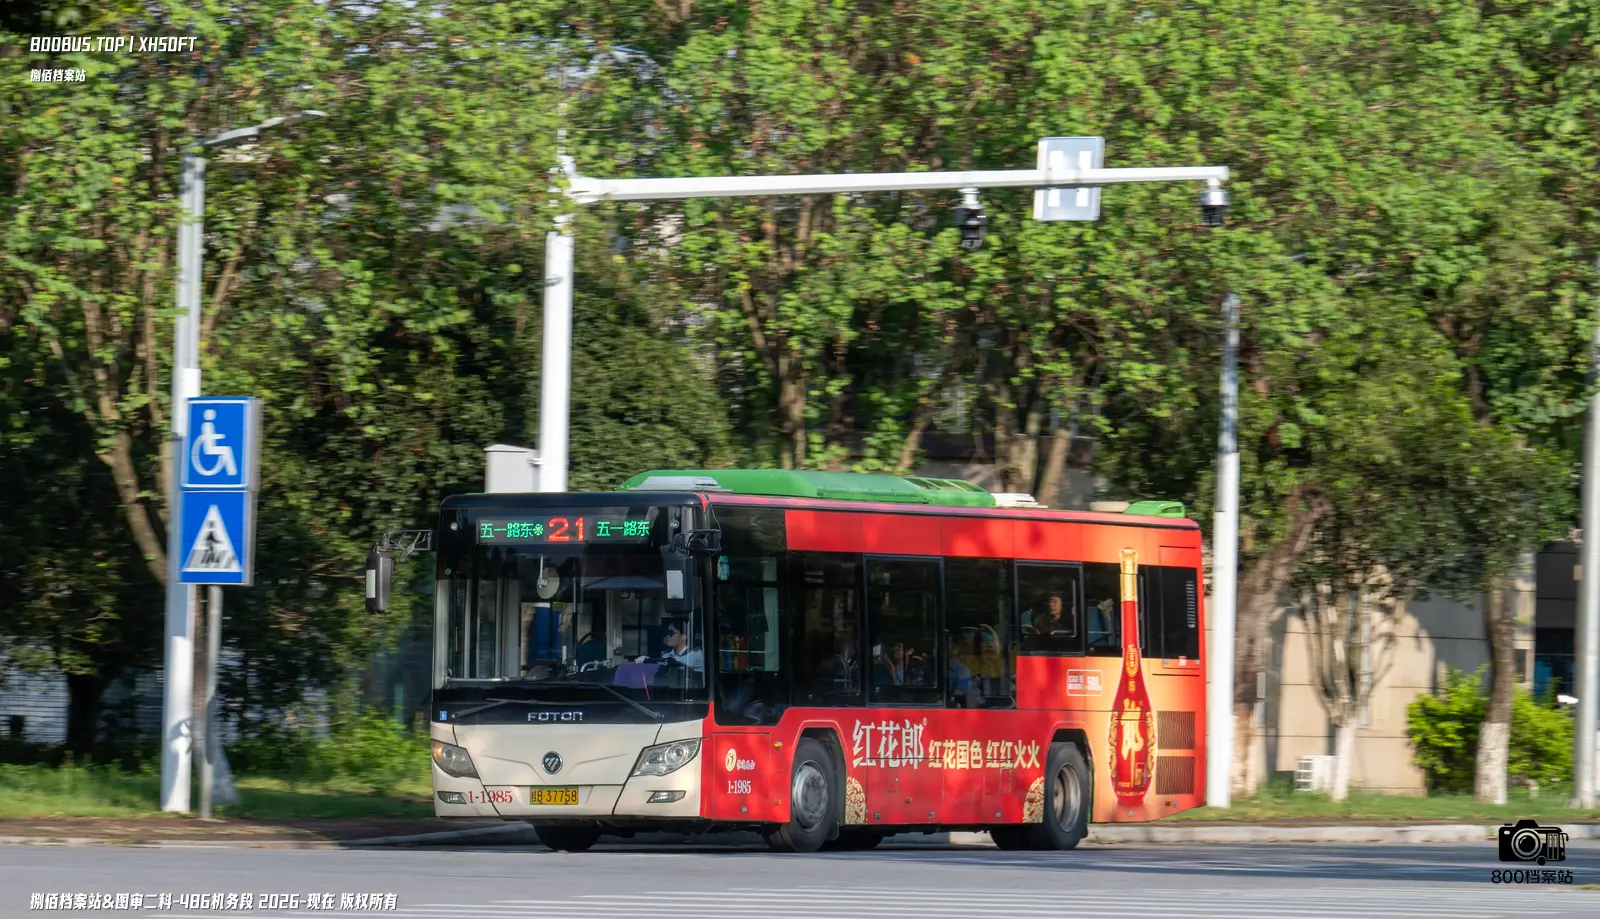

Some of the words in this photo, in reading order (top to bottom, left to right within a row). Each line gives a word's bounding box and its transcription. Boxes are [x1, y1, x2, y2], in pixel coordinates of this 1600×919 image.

[480, 522, 534, 538] 五一路东
[548, 516, 585, 542] 21
[596, 520, 650, 537] 五一路东
[527, 711, 583, 722] FOTON
[852, 718, 925, 769] 红花郎
[928, 740, 983, 769] 红花国色
[985, 740, 1041, 769] 红红火火
[727, 779, 752, 794] 1-1985
[468, 790, 513, 804] 1-1985
